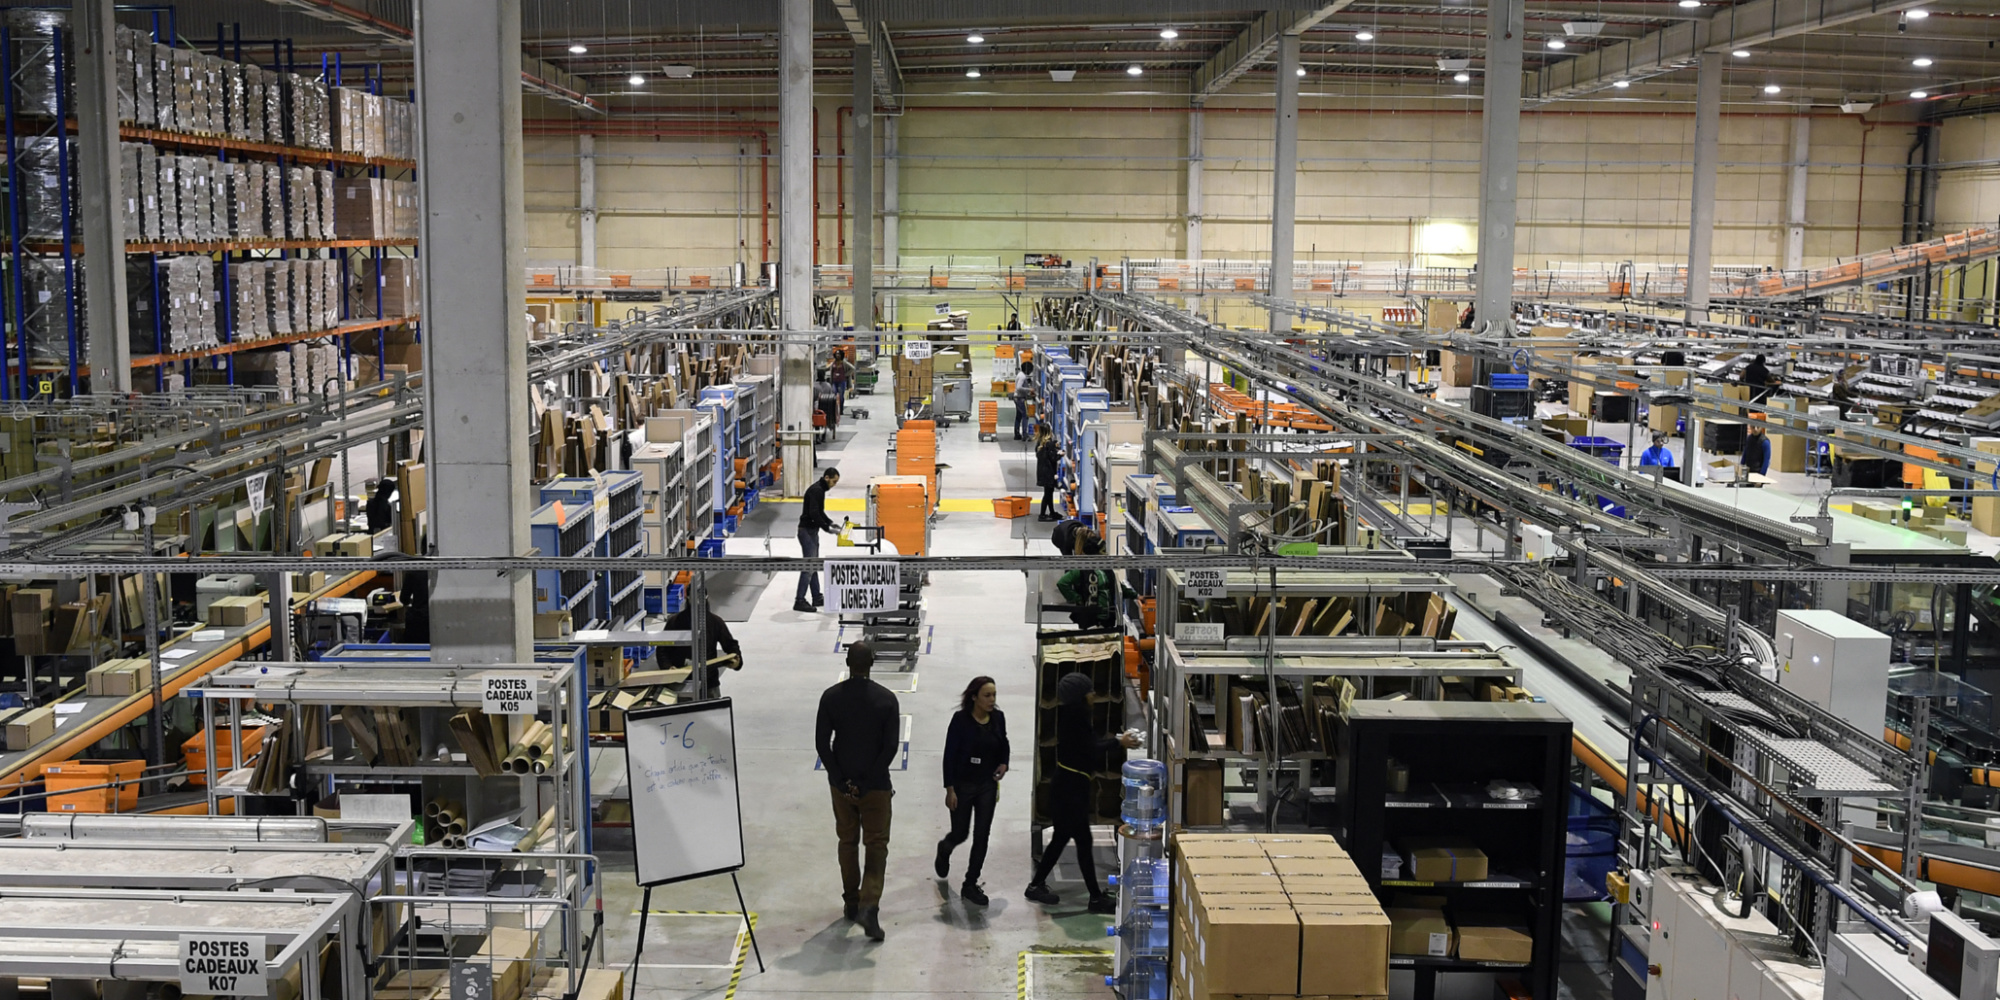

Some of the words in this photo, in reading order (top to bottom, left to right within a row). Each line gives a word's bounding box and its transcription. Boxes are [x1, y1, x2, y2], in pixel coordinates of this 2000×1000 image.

[41, 383, 50, 391] G
[831, 564, 860, 585] POSTES
[861, 564, 897, 585] CADEAUX
[1190, 571, 1219, 579] POSTES
[1187, 579, 1224, 588] CADEAUX
[1198, 588, 1213, 596] K02
[841, 588, 868, 609] LIGNES
[869, 588, 884, 609] 3&4
[488, 679, 527, 690] POSTES
[485, 690, 533, 701] CADEAUX
[500, 701, 519, 712] K05
[660, 721, 695, 749] J-6
[189, 941, 249, 957] POSTES
[185, 958, 259, 974] CADEAUX
[208, 976, 237, 991] K07
